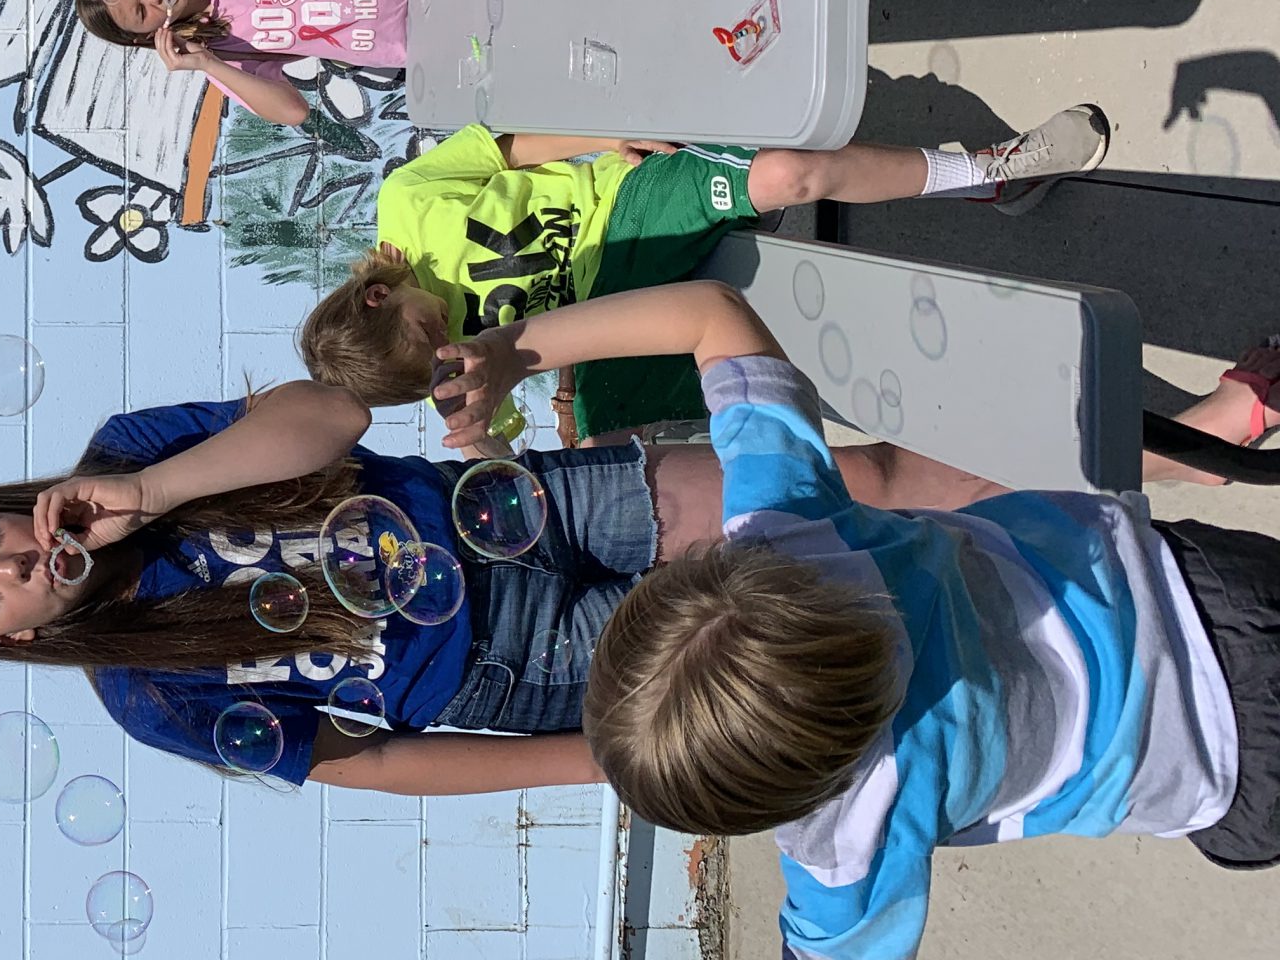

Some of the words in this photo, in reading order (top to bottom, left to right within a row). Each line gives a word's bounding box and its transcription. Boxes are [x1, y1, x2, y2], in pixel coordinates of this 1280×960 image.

[250, 8, 296, 51] GO
[350, 29, 375, 52] GO
[713, 181, 727, 199] 63
[462, 211, 557, 337] 5K
